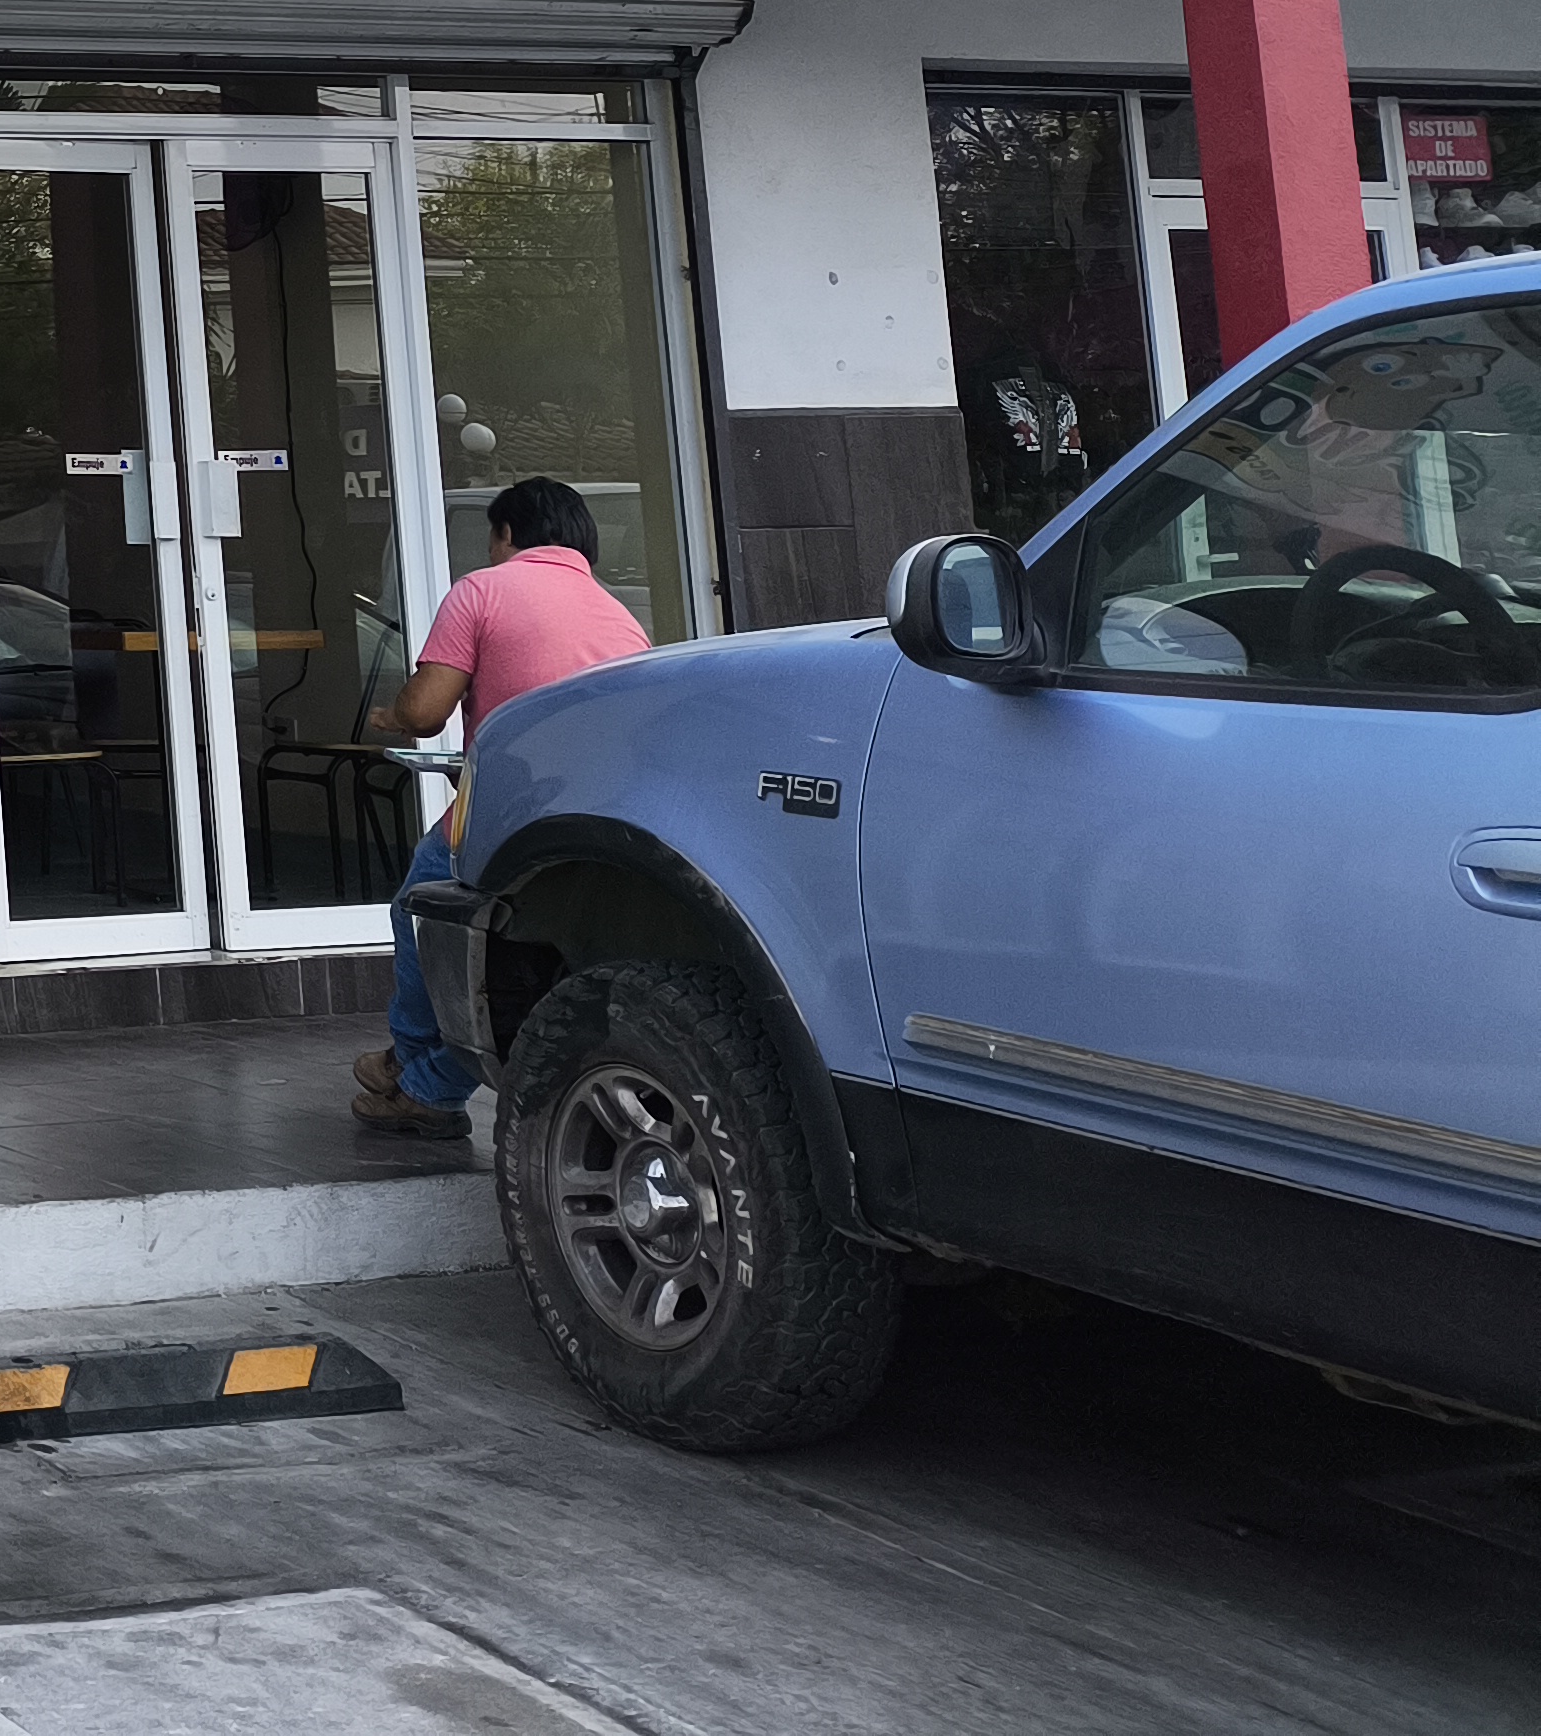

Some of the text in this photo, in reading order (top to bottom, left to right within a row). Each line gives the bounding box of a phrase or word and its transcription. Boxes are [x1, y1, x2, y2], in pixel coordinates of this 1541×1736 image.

[1408, 120, 1477, 137] SISTEMA
[1435, 141, 1455, 157] DE
[1407, 160, 1488, 177] APARTADO
[757, 772, 838, 805] F-150
